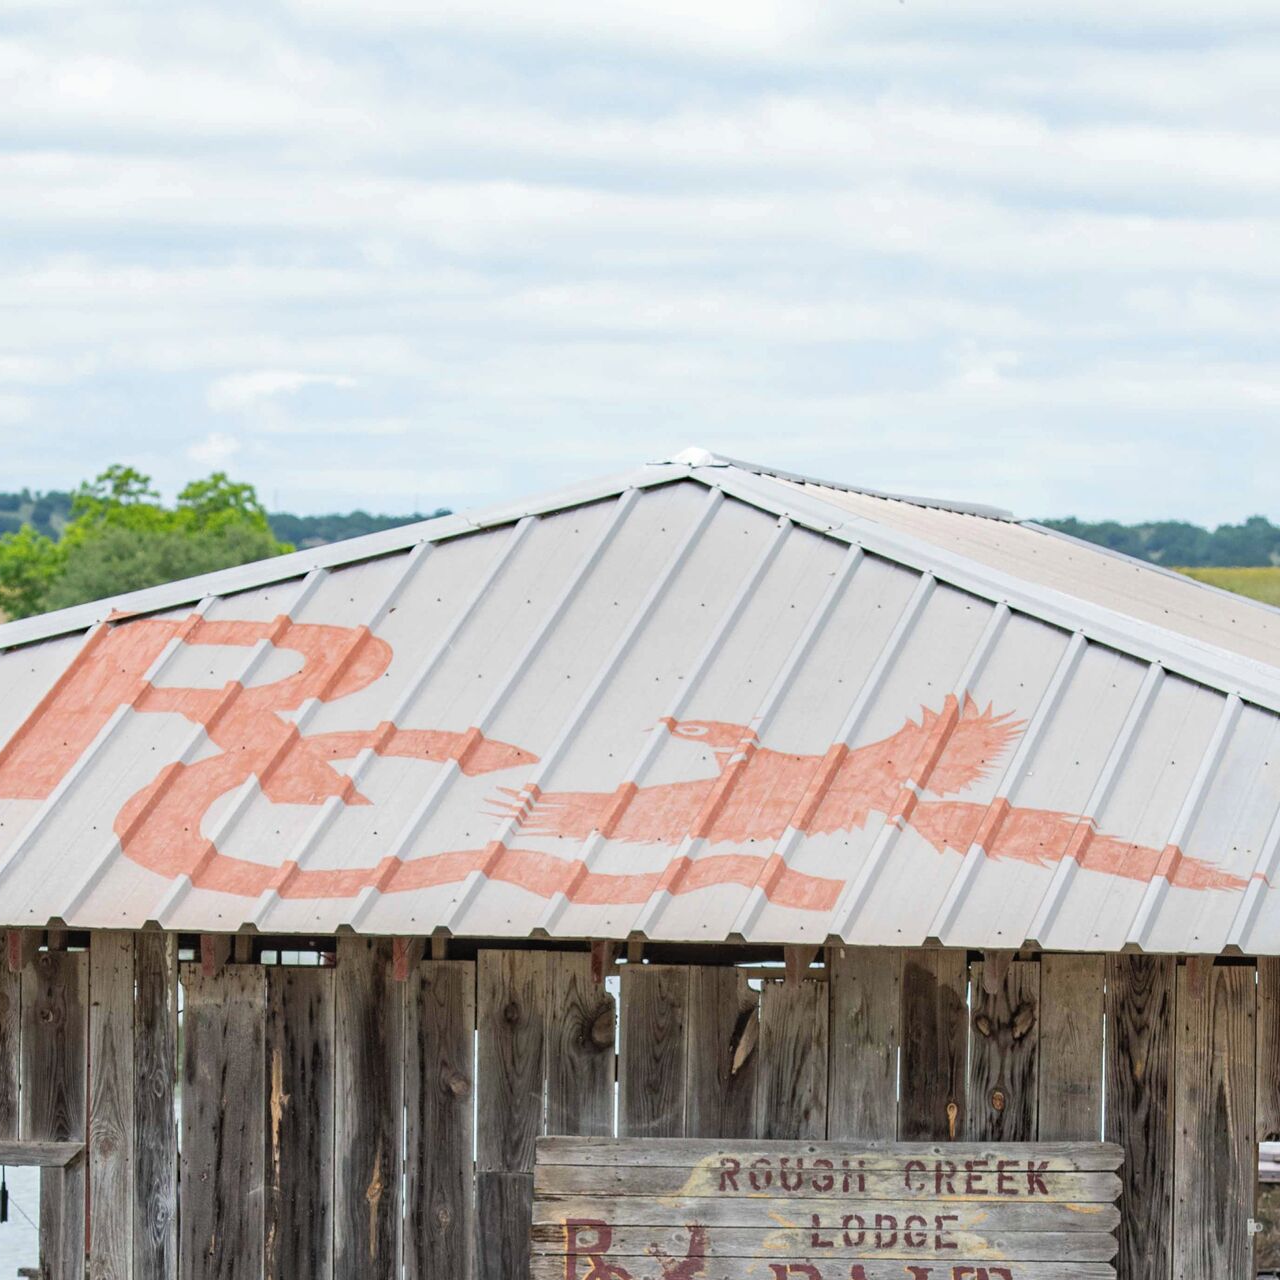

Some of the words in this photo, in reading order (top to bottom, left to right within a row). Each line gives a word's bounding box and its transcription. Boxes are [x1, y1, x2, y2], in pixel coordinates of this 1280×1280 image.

[719, 1158, 866, 1192] ROUGH
[904, 1159, 1050, 1195] CREEK
[809, 1213, 959, 1250] LODGE
